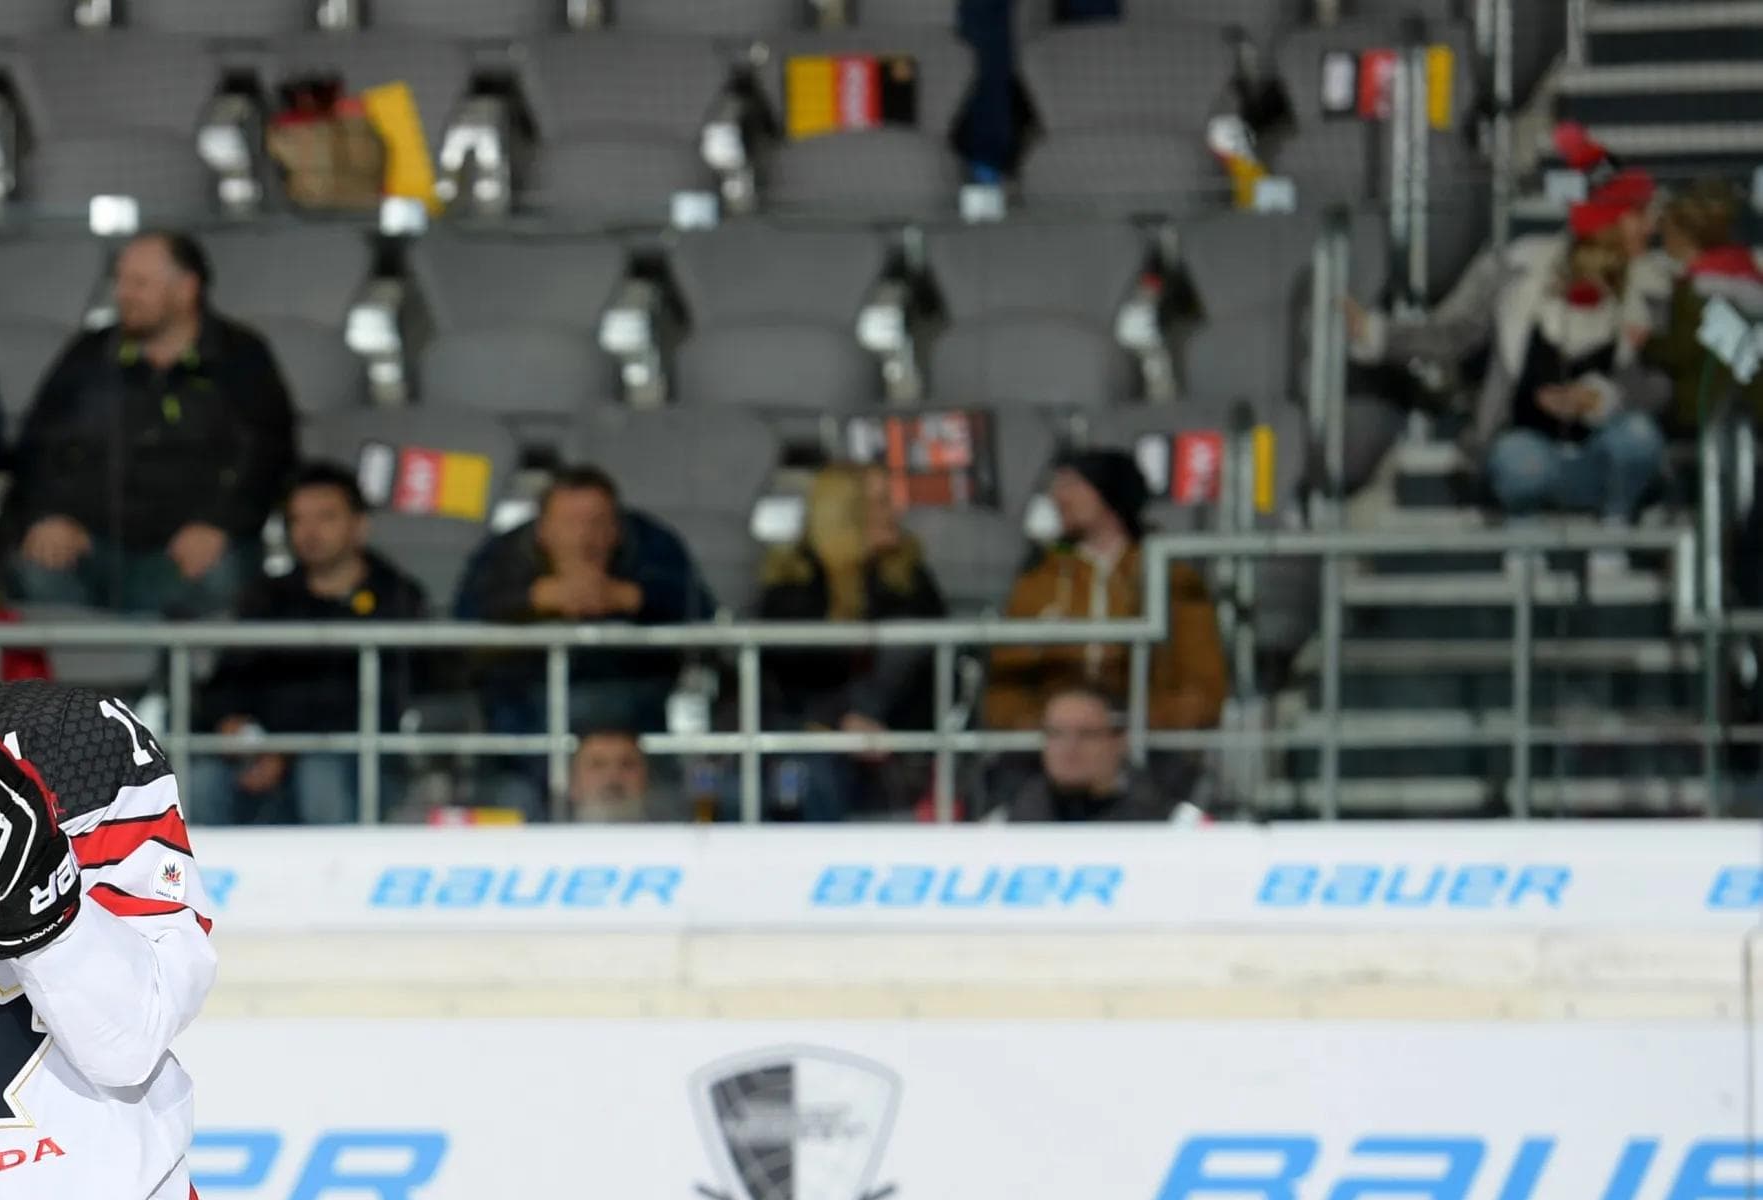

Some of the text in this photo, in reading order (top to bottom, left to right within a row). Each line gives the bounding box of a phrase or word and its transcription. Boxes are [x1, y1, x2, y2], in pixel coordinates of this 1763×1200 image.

[367, 865, 686, 910] BAUER
[808, 864, 1126, 909] BAUER
[1254, 862, 1575, 909] BAUER
